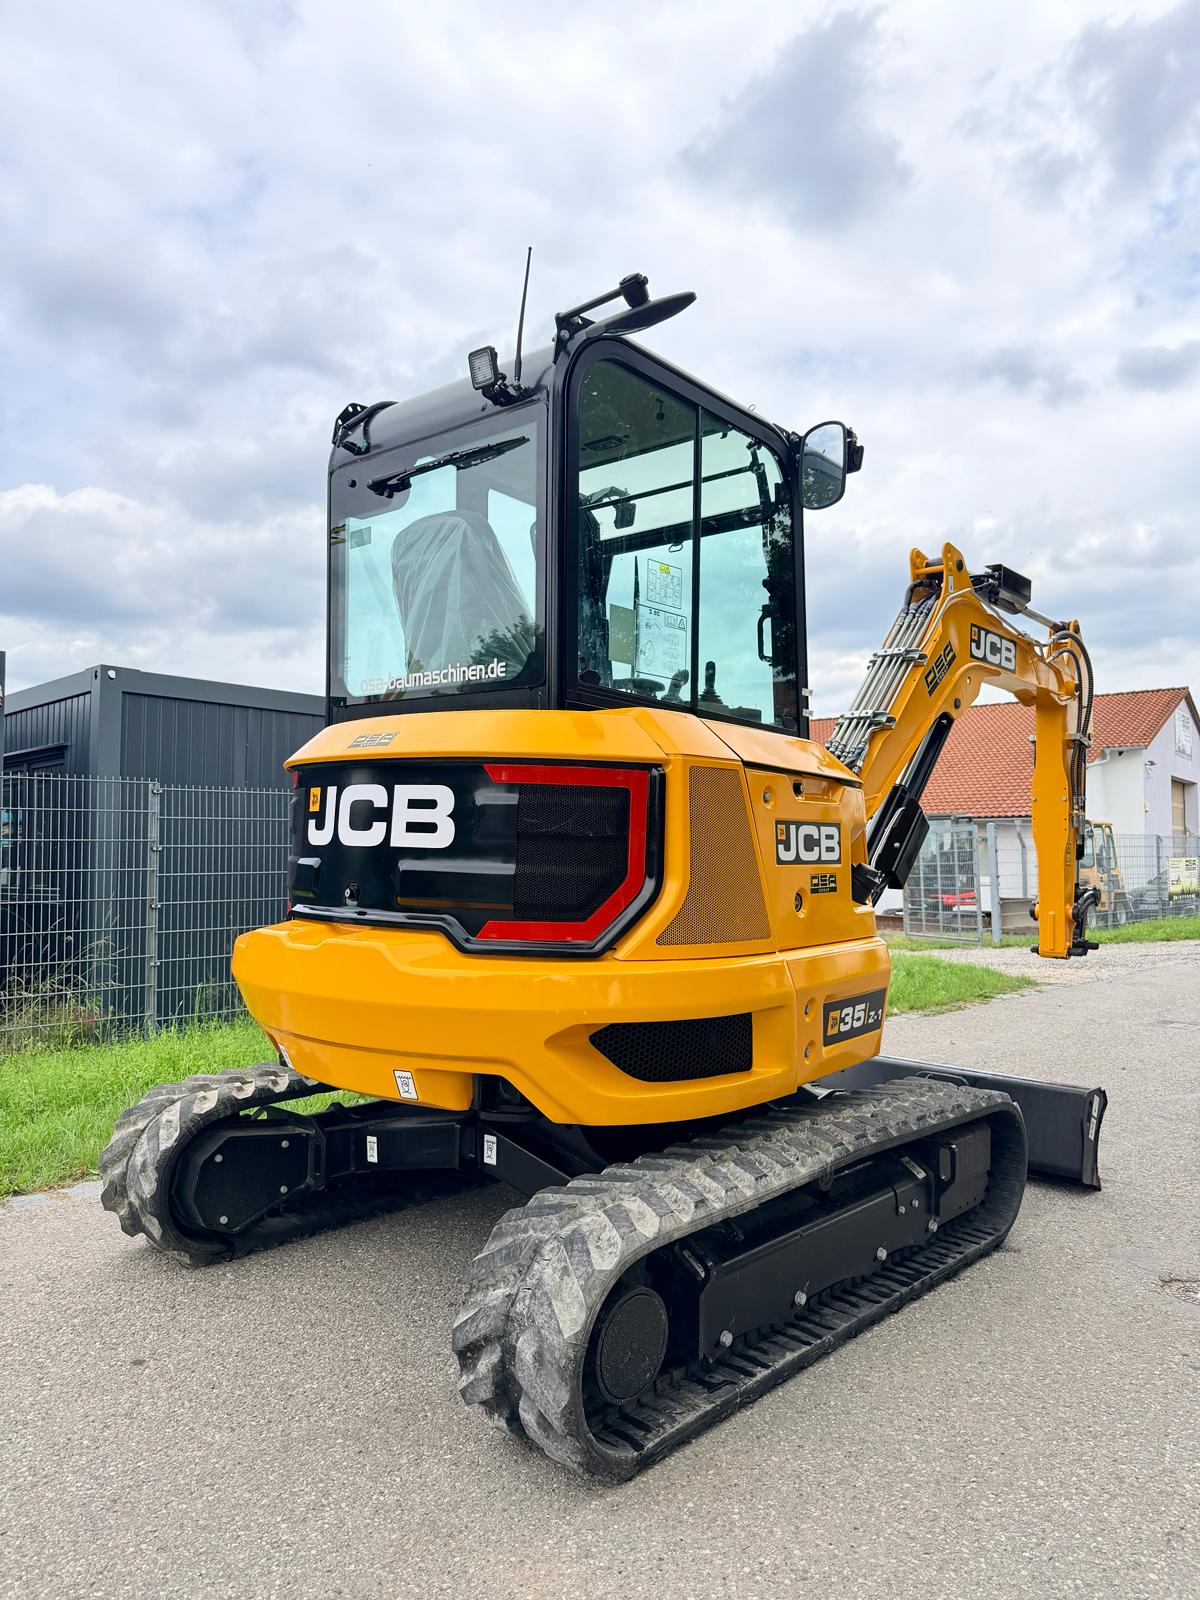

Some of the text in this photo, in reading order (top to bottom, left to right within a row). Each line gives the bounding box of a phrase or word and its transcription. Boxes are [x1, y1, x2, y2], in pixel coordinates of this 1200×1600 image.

[971, 627, 1016, 671] JCB
[308, 784, 455, 848] JCB
[778, 825, 840, 861] JCB
